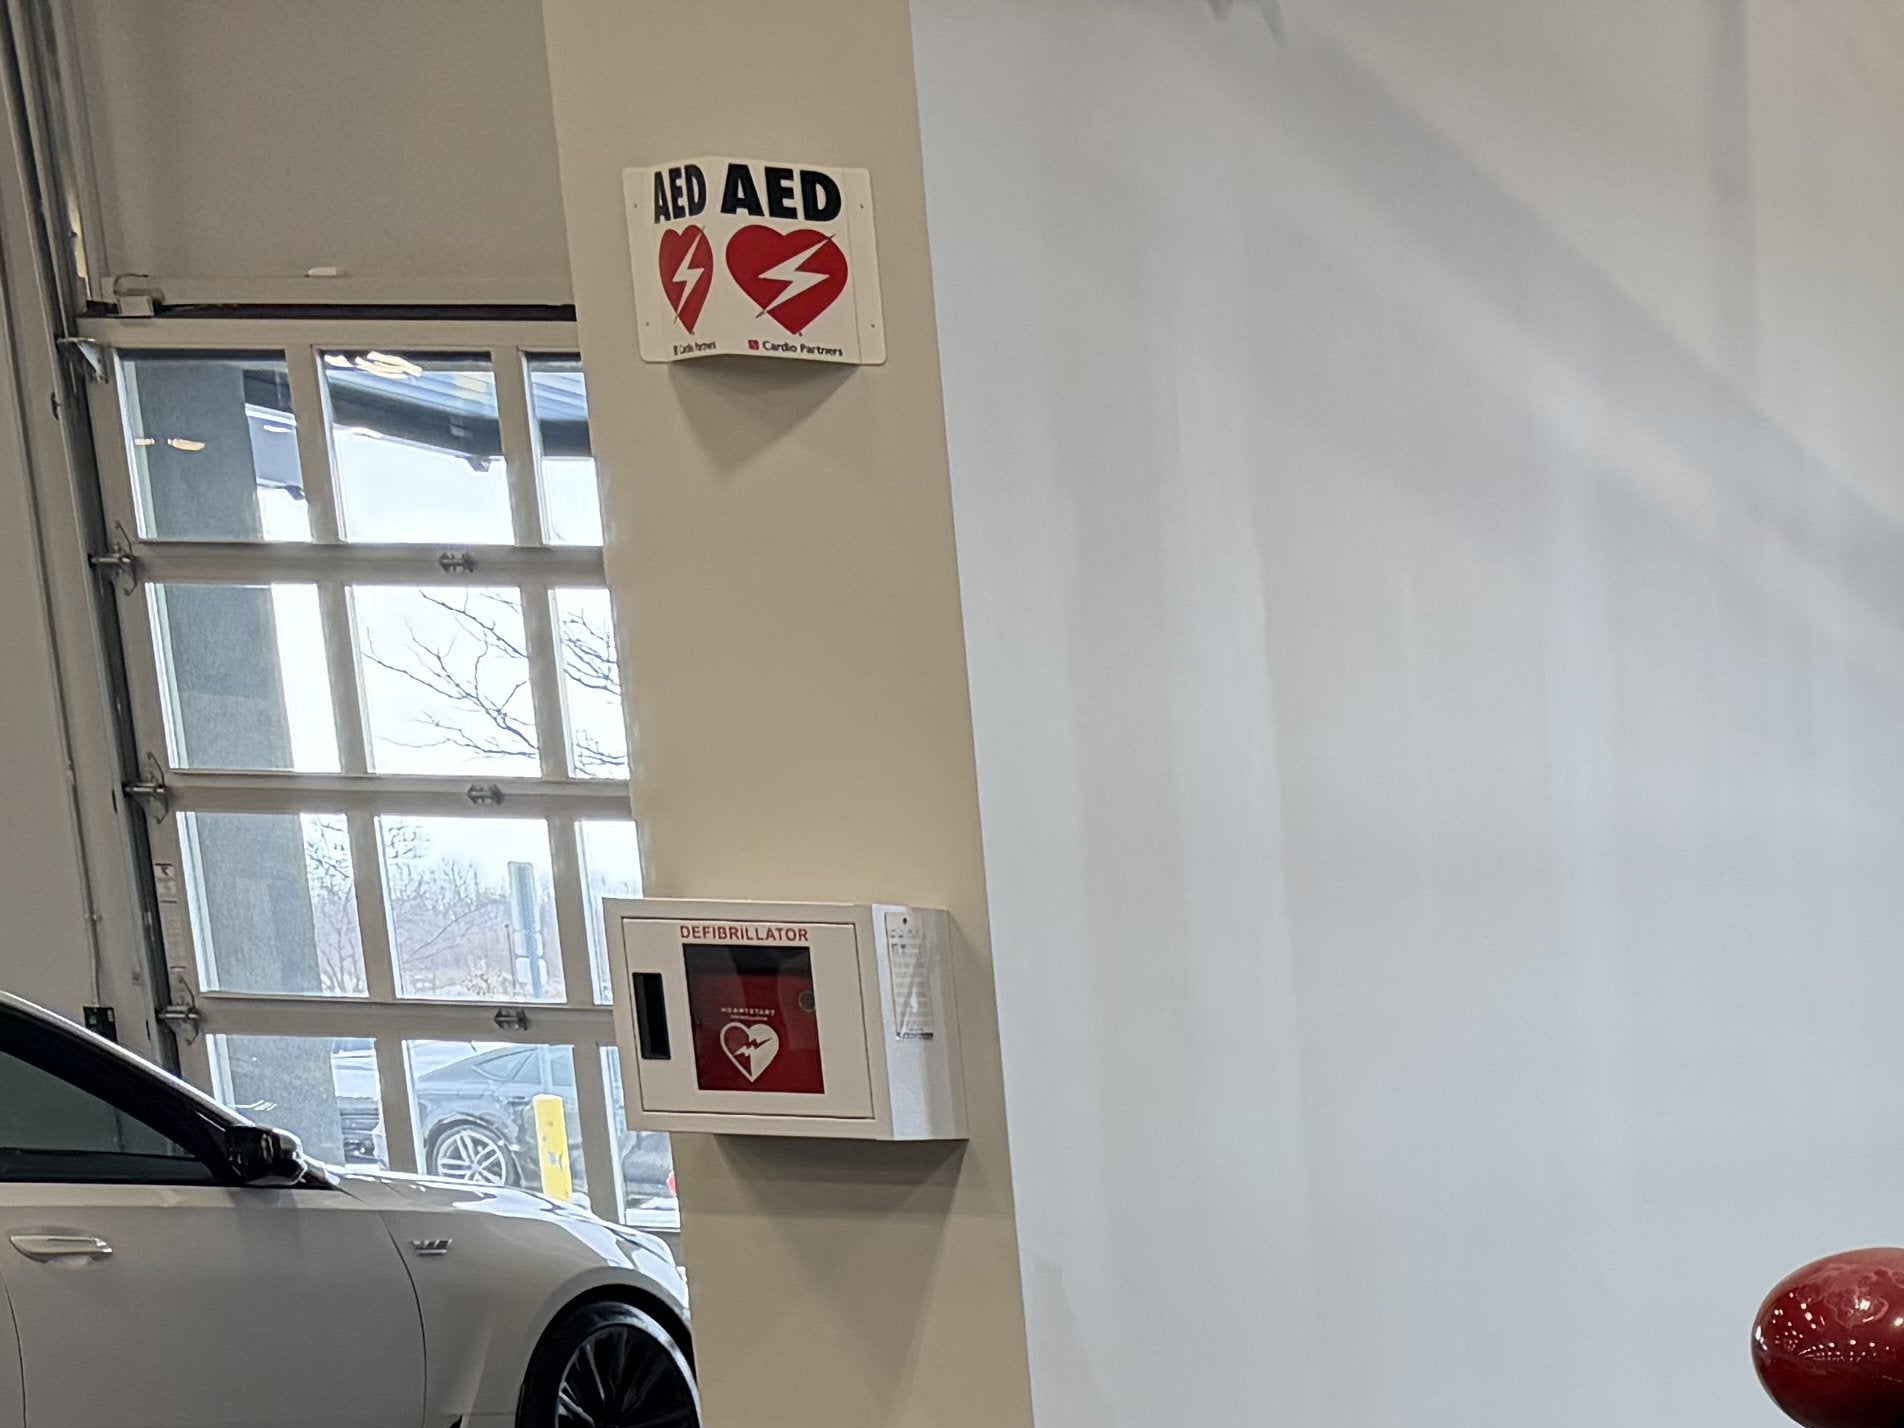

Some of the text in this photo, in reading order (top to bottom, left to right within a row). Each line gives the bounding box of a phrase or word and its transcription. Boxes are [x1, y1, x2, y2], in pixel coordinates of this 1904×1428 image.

[654, 164, 707, 224] AED
[720, 163, 842, 222] AED
[762, 340, 843, 356] Cardio Partners
[680, 925, 809, 942] DEFIBRILLATOR
